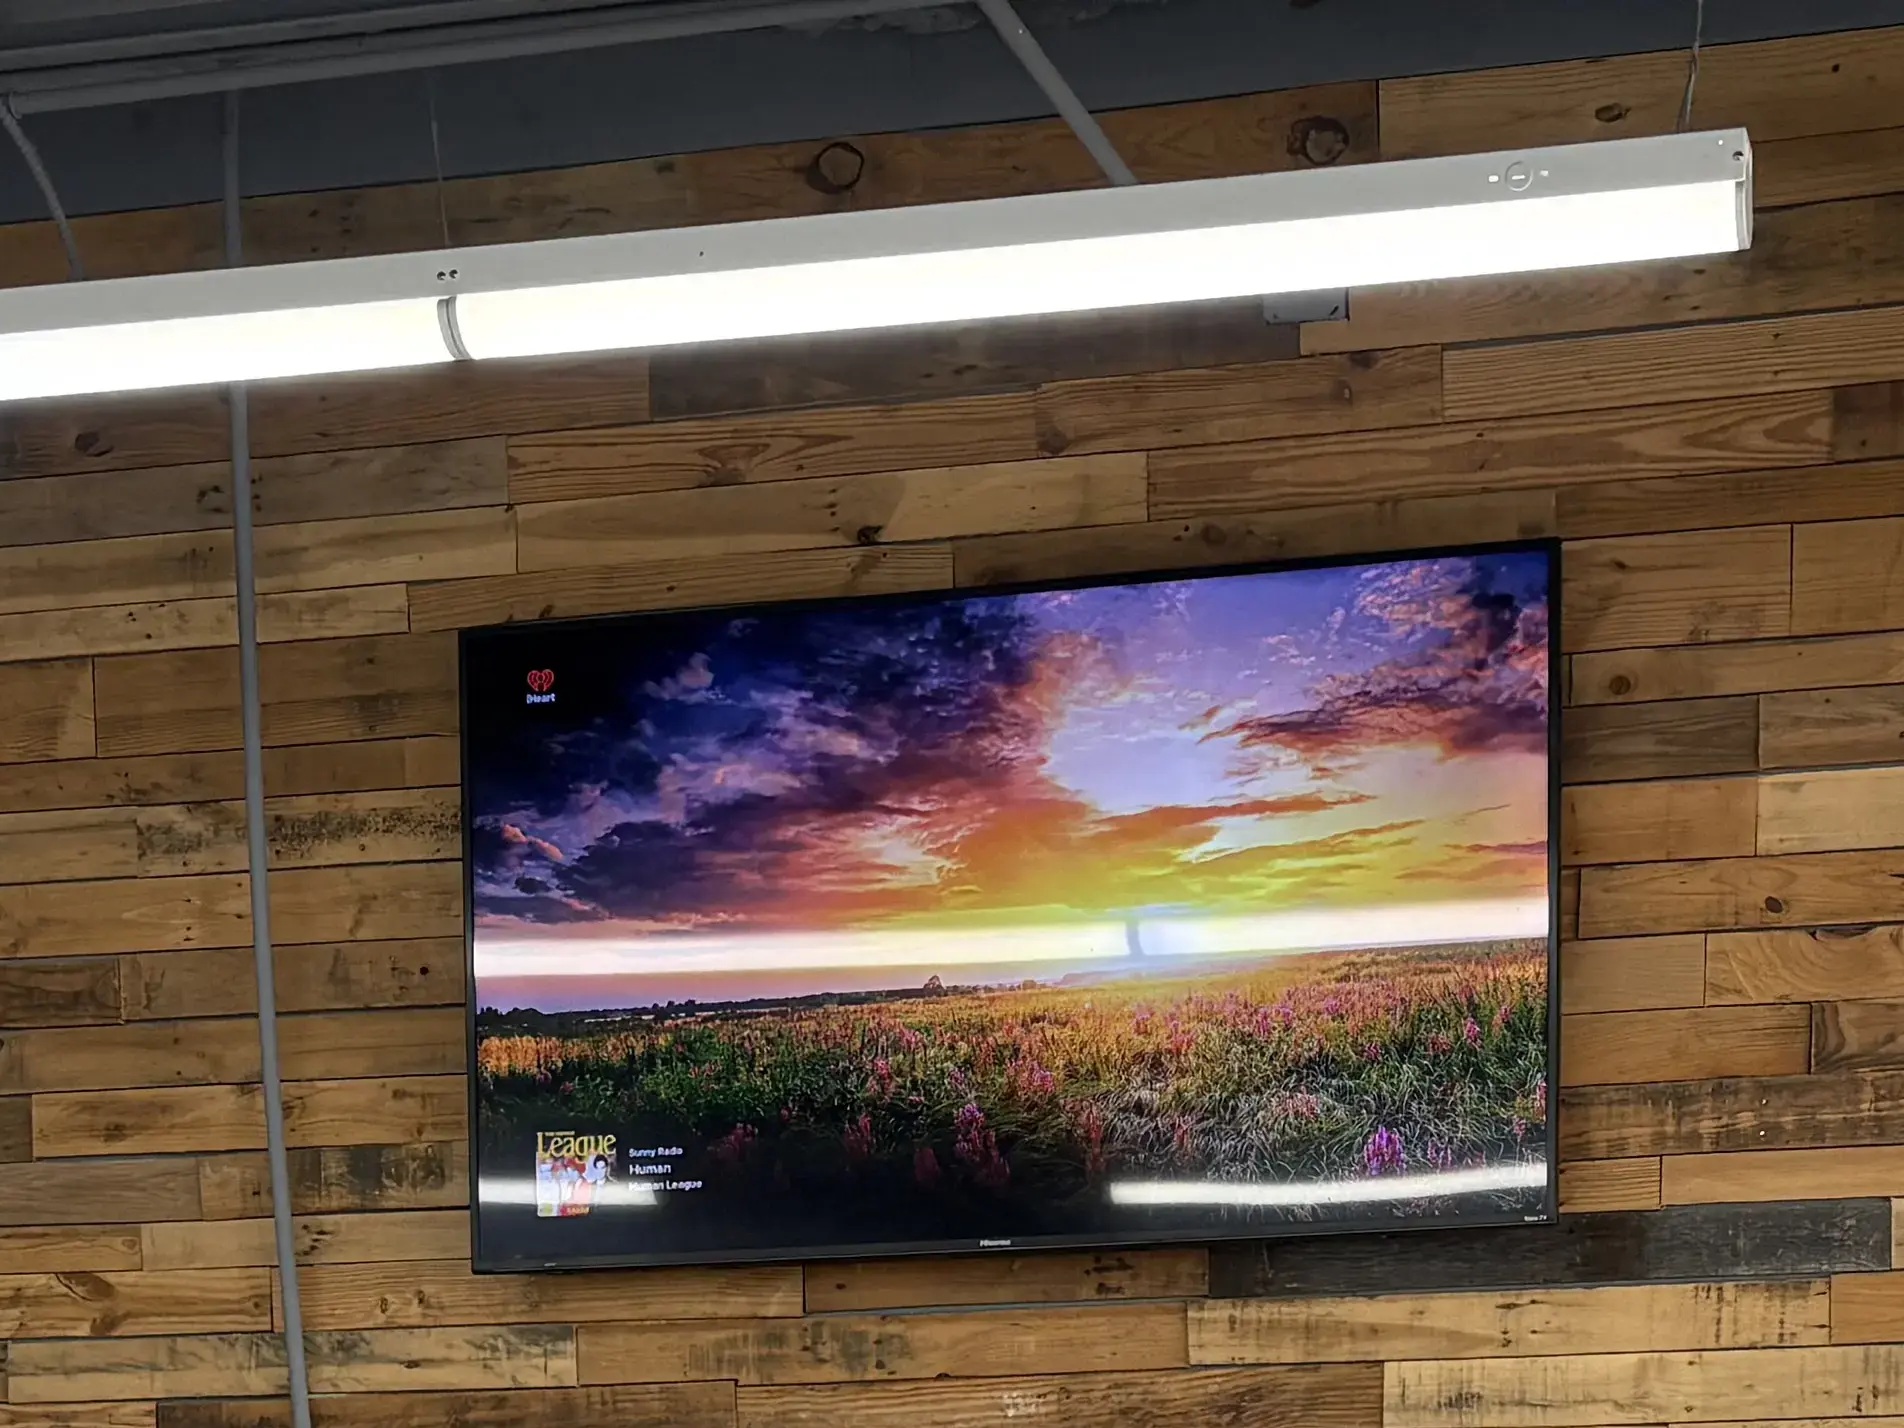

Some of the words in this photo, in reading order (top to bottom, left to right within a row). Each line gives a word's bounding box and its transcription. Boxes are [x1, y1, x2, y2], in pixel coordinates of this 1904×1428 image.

[536, 1131, 617, 1164] League
[628, 1148, 656, 1158] Sunny
[657, 1146, 684, 1156] Radio
[629, 1164, 672, 1175] Human
[666, 1180, 703, 1191] League
